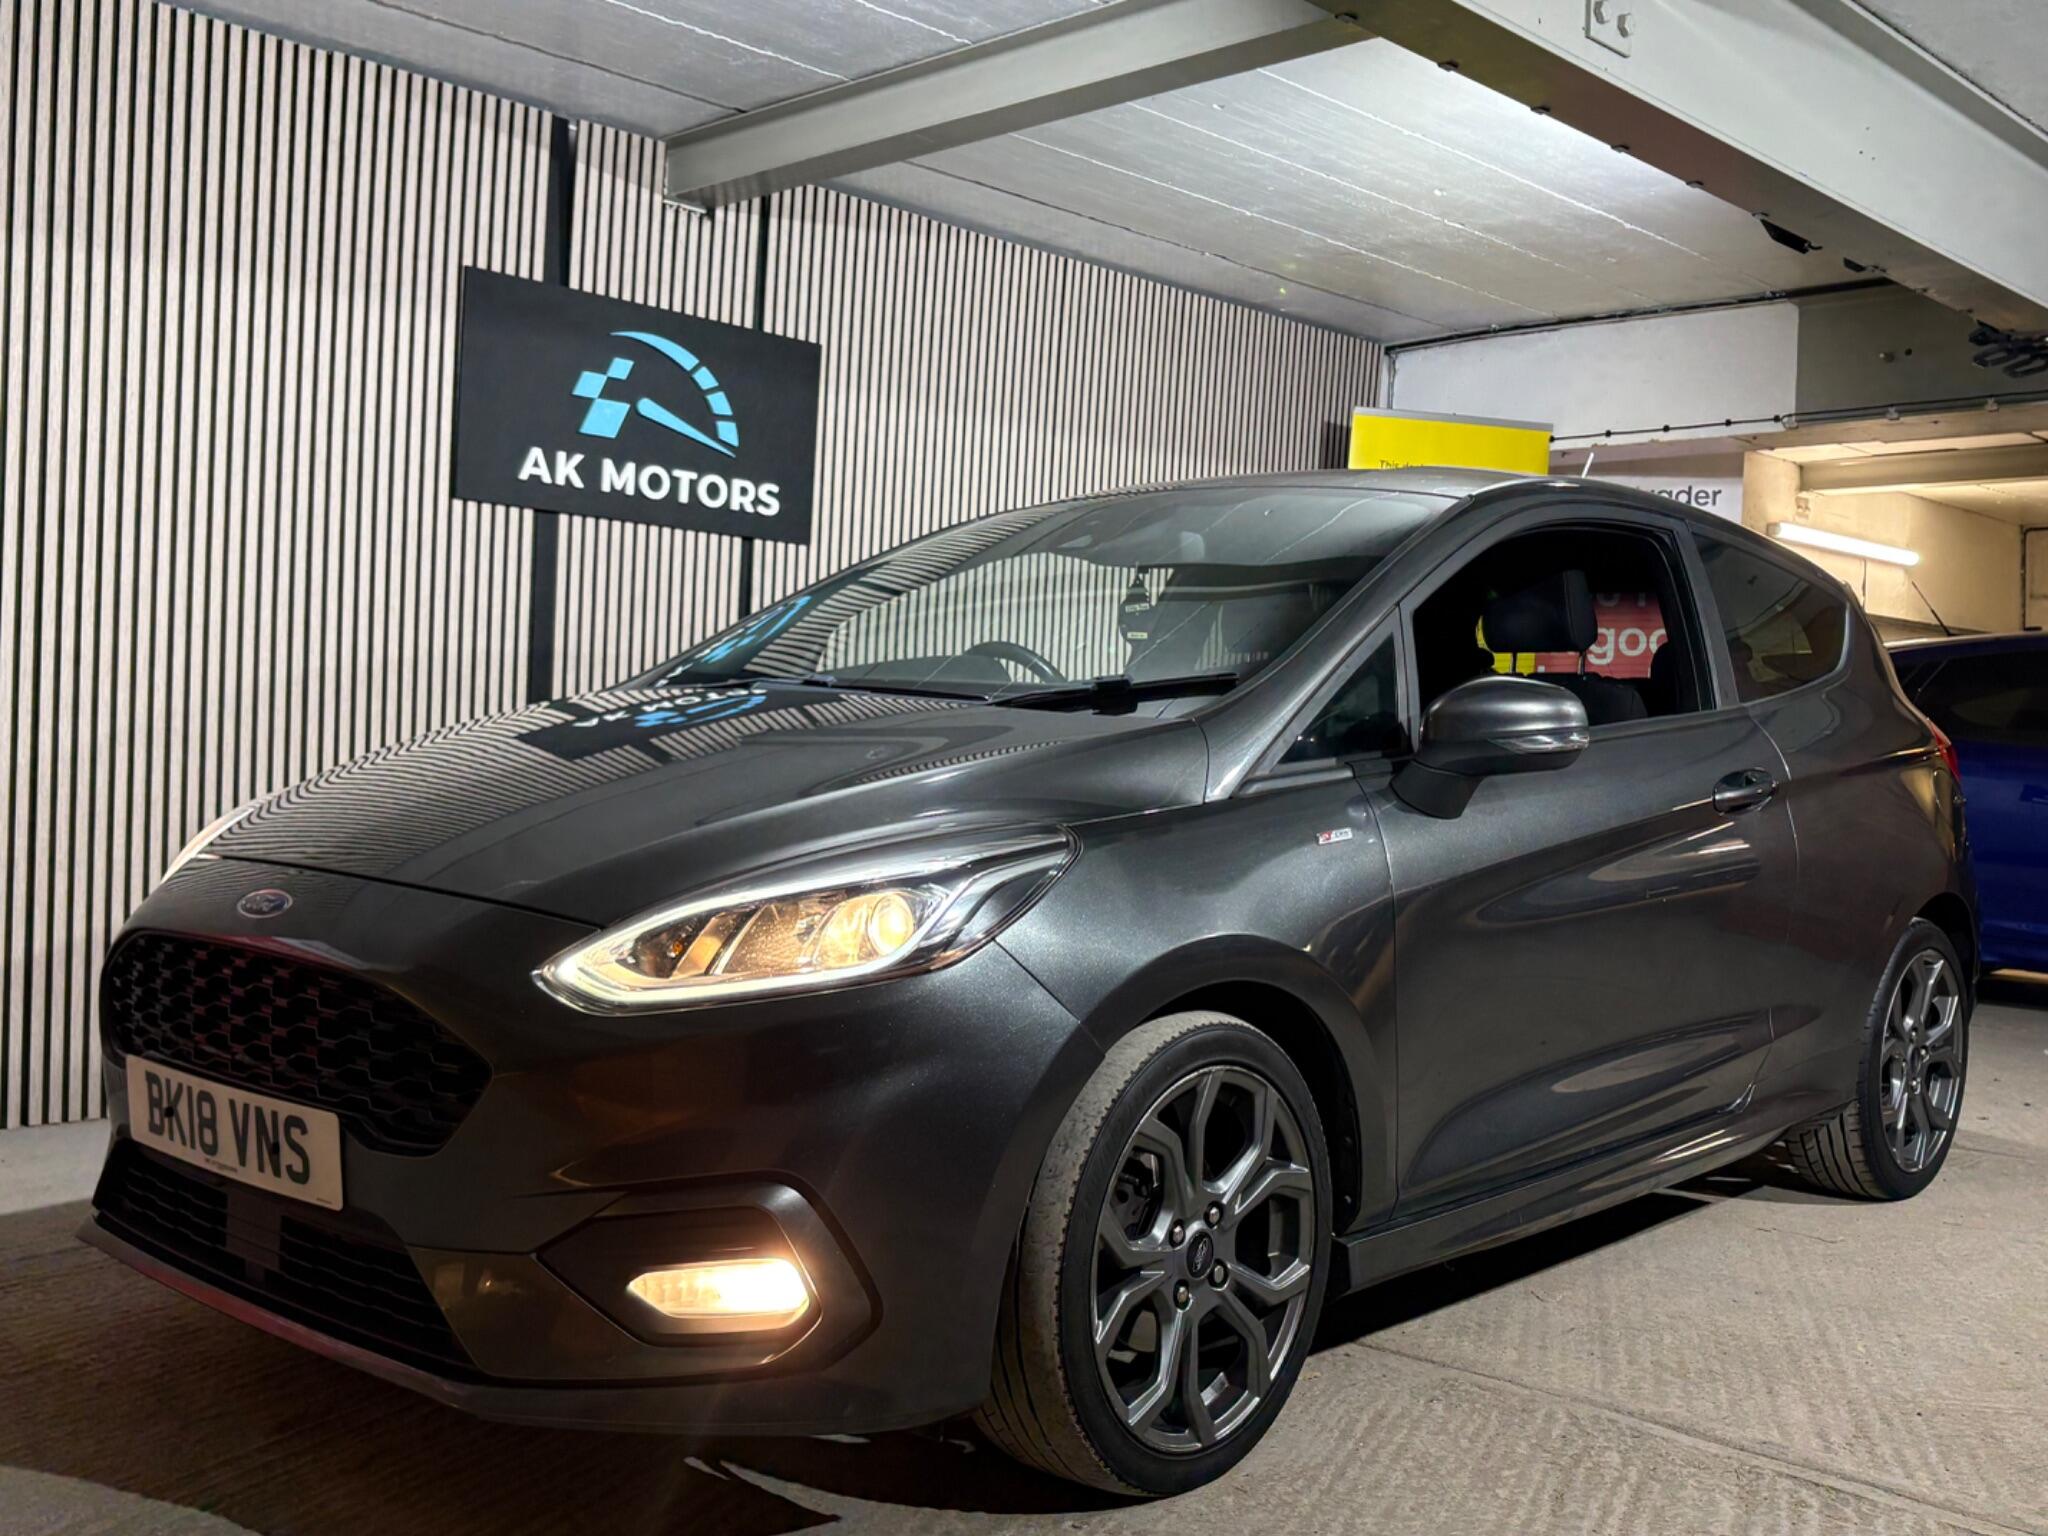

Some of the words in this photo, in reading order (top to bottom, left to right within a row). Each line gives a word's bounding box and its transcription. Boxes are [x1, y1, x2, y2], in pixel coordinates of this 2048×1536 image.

[518, 446, 585, 489] AK
[600, 457, 781, 516] MOTORS
[145, 1069, 219, 1157] BK18
[229, 1098, 311, 1185] VNS
